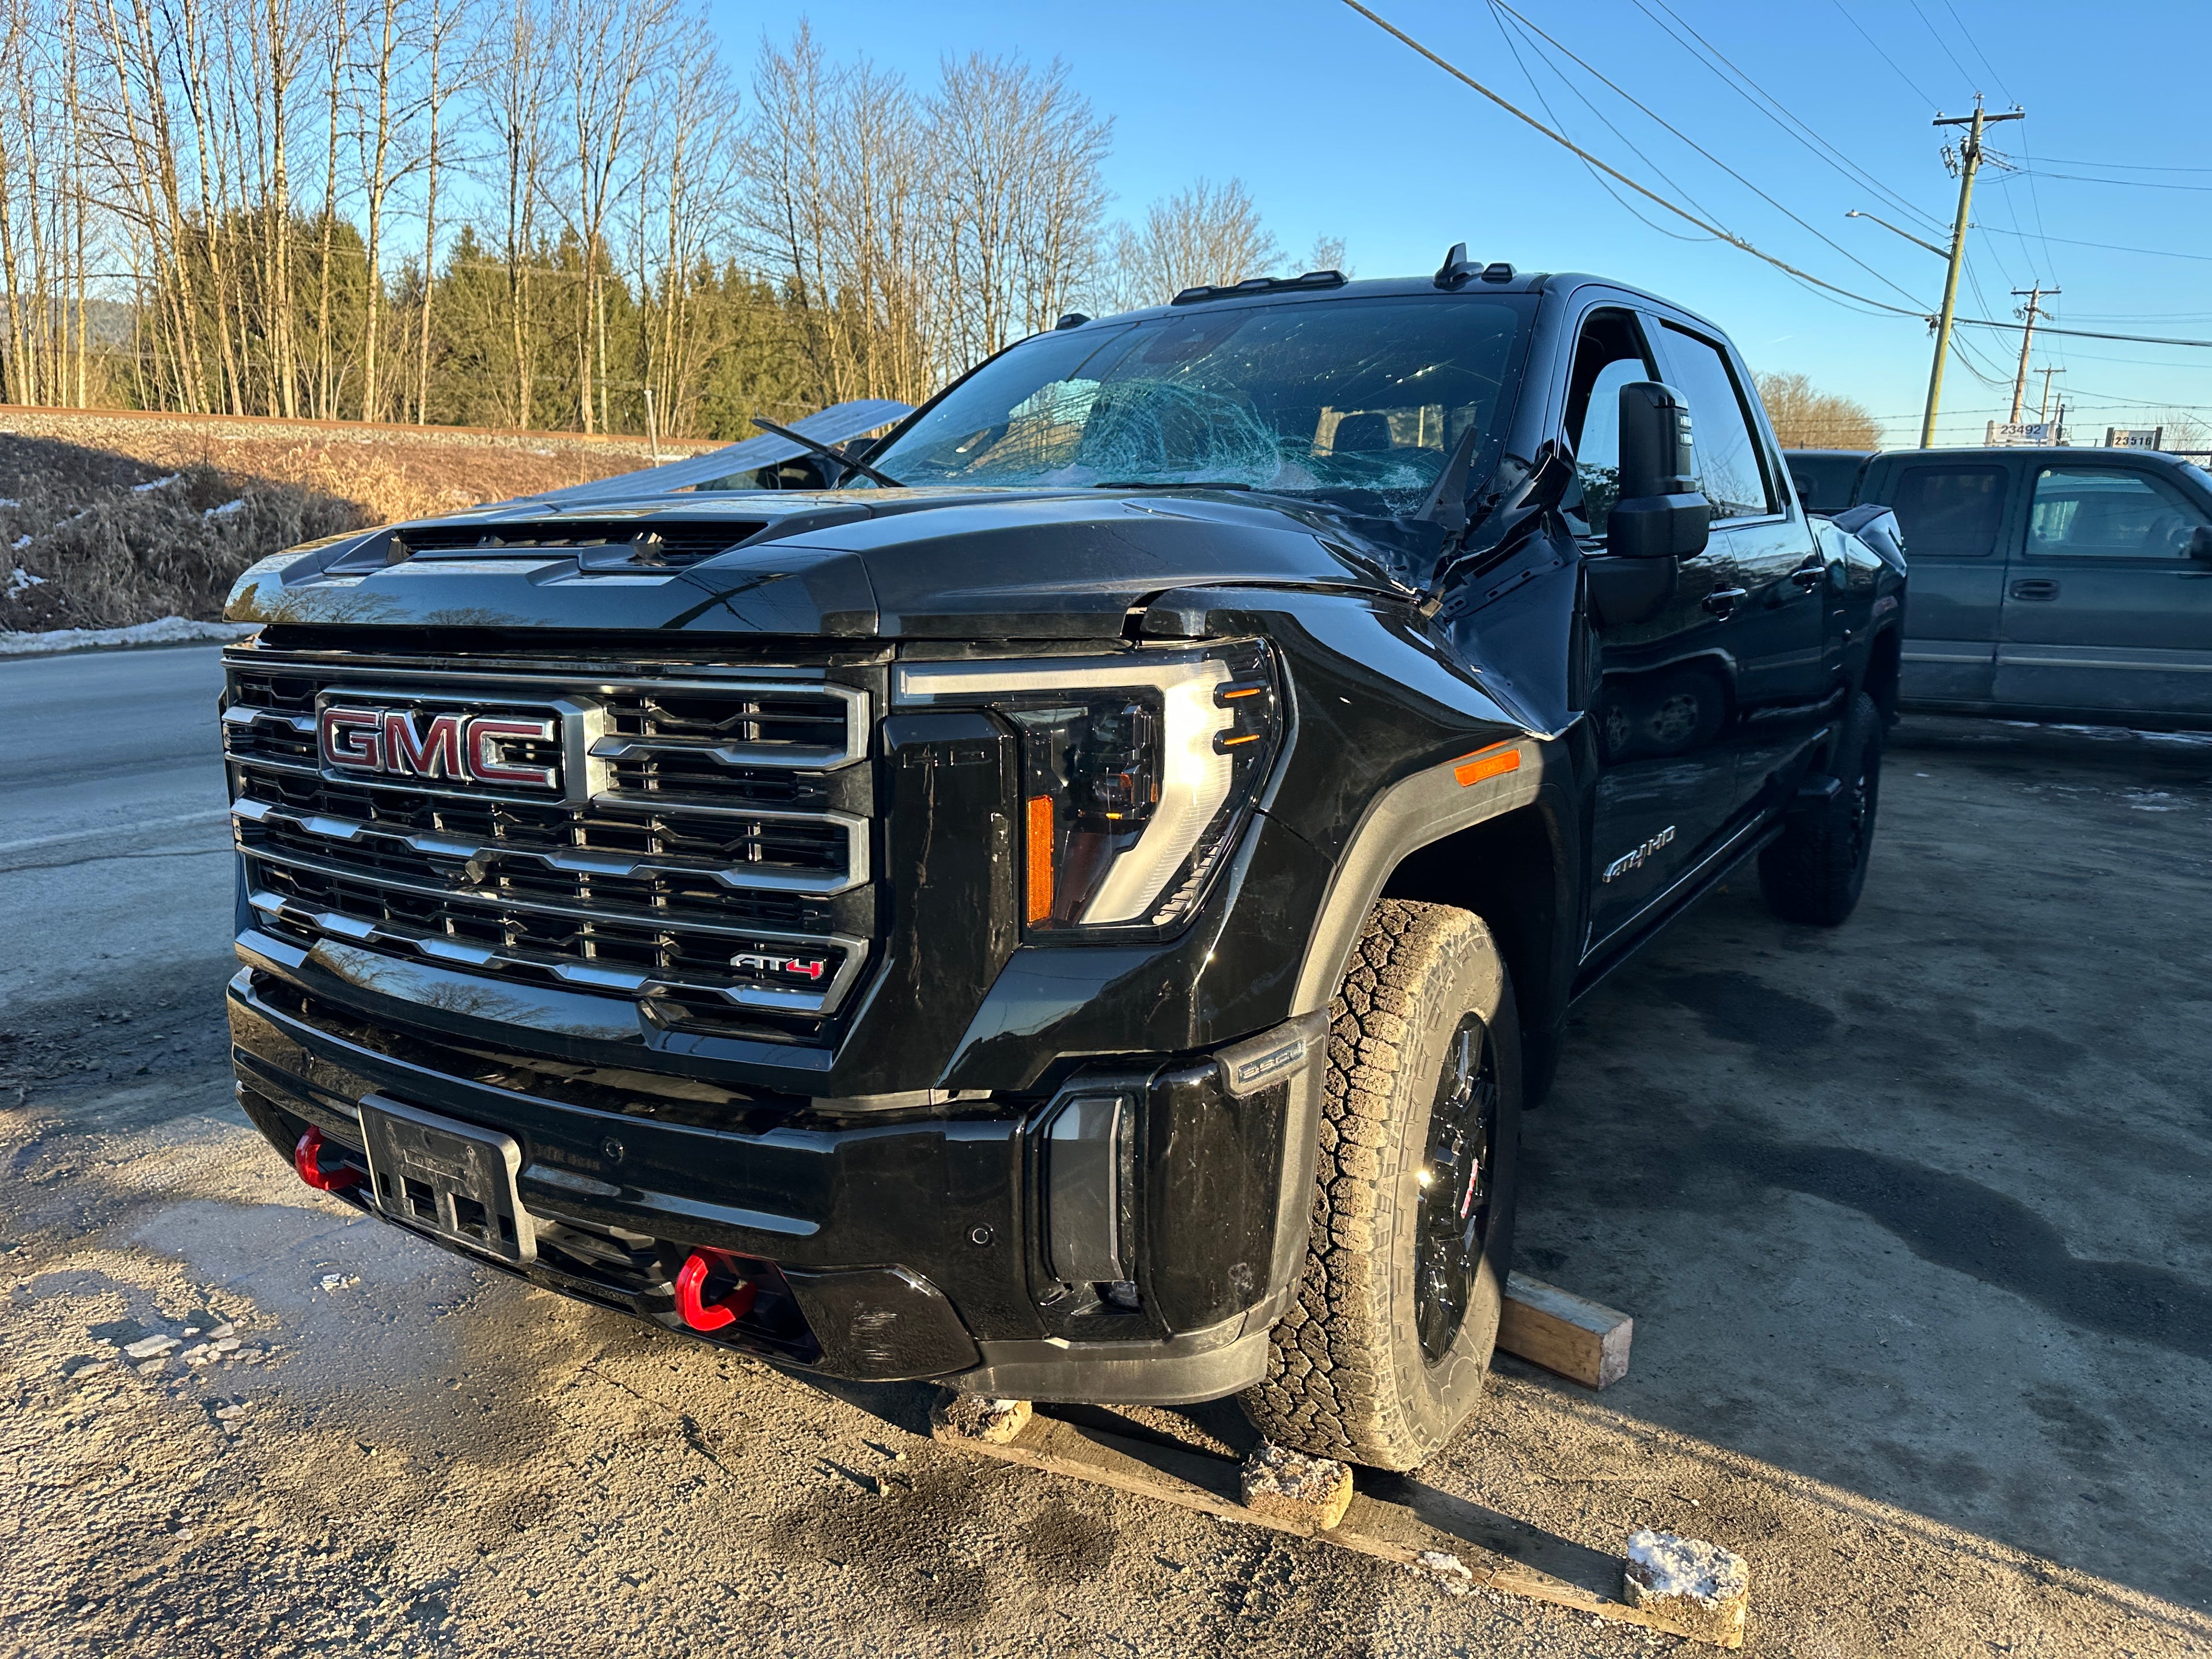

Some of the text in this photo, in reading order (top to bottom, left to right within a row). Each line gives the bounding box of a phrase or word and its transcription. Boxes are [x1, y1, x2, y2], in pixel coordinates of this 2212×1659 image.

[2000, 425, 2041, 434] 23492
[323, 704, 556, 790] GMC
[730, 953, 824, 980] AT4
